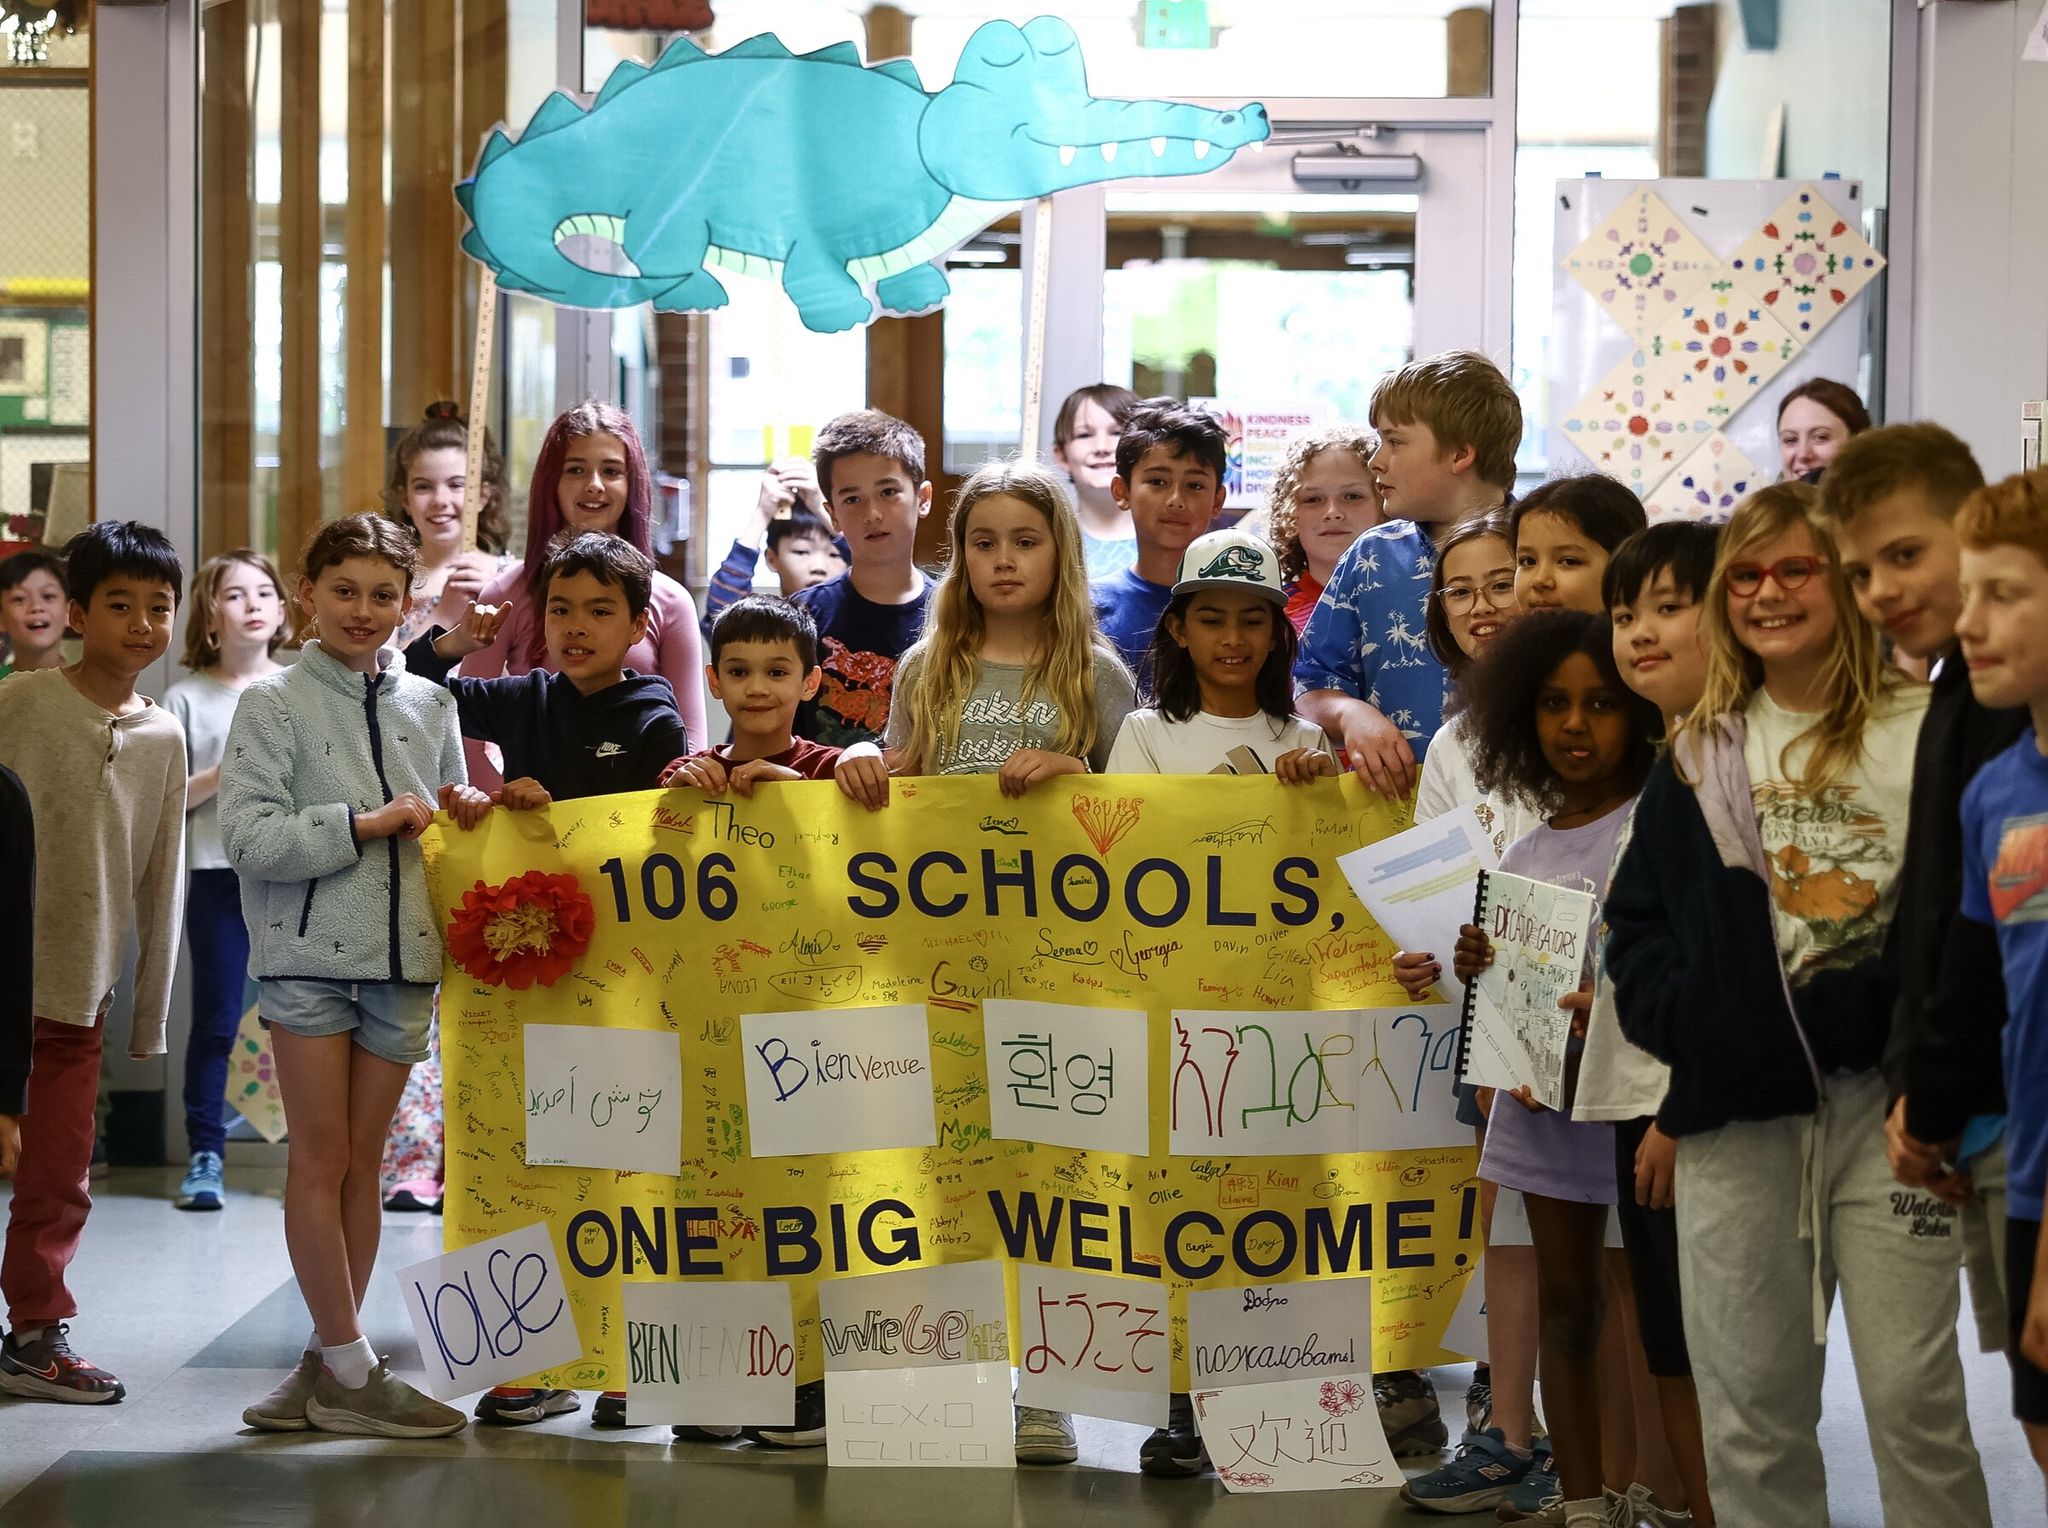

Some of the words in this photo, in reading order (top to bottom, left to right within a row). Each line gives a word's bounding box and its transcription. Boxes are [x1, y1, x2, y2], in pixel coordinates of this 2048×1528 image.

[1247, 415, 1311, 425] KINDNESS
[1247, 428, 1287, 438] PEACE
[601, 741, 622, 753] NIKE
[702, 799, 775, 848] Theo
[778, 864, 811, 881] Ethan
[598, 851, 739, 923] 106
[846, 848, 1345, 933] SCHOOLS,
[761, 898, 798, 913] George
[855, 931, 888, 943] Nora
[1035, 927, 1083, 959] Serena
[1255, 929, 1290, 946] Oliver
[1311, 938, 1380, 961] Welcome
[1536, 923, 1578, 959] GATORS
[1122, 929, 1184, 981] Georgia
[930, 960, 1013, 999] Gavin!
[754, 1037, 926, 1102] Bienvenue
[1000, 1033, 1114, 1116] 환영
[786, 1167, 805, 1178] Joy
[1414, 1154, 1464, 1168] Sebastian
[1266, 1170, 1300, 1189] Kian
[1148, 1188, 1184, 1205] Ollie
[565, 1206, 724, 1279] ONE
[762, 1198, 922, 1277] BIG
[986, 1186, 1478, 1280] WELCOME!
[1242, 1287, 1289, 1313] Добро
[1025, 1286, 1165, 1374] ようこそ
[627, 1320, 794, 1386] BIENVENIDO
[1196, 1332, 1355, 1377] пожаловать!
[1229, 1410, 1383, 1469] 欢迎
